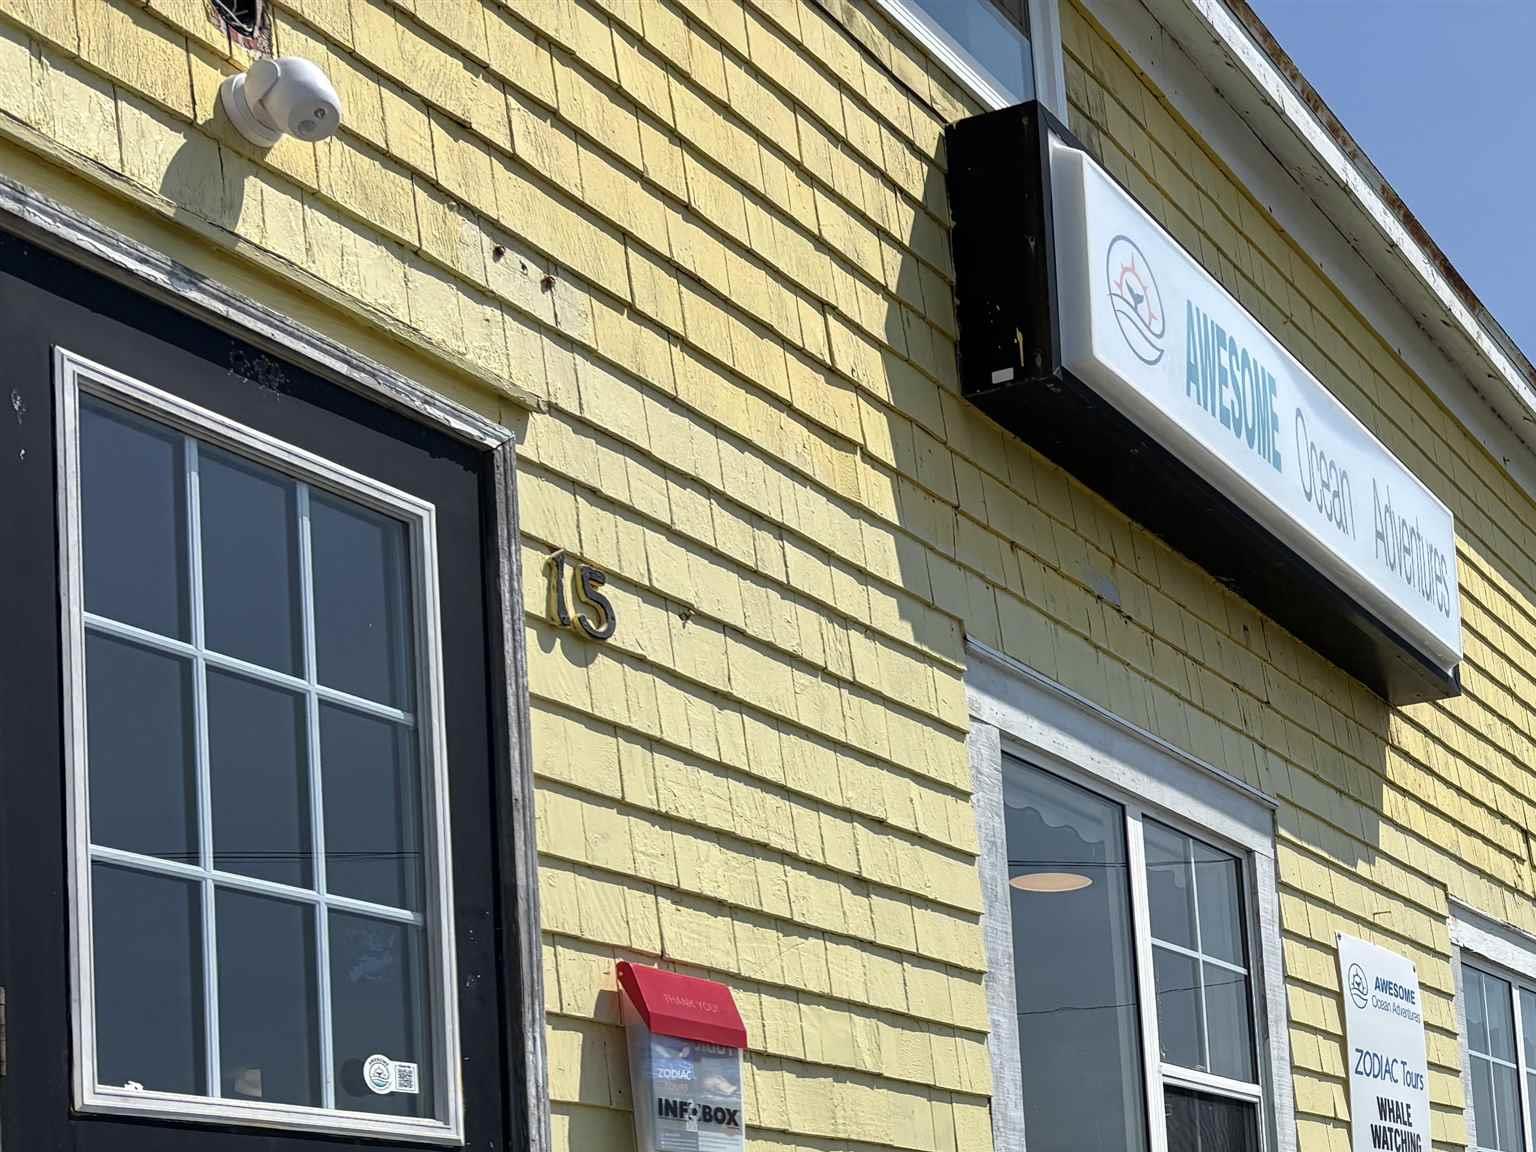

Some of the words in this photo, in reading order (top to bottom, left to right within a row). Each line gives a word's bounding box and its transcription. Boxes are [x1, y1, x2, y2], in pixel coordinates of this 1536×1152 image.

[1187, 300, 1282, 474] AWESOME
[1296, 408, 1356, 540] Ocean
[1372, 477, 1451, 618] Adventures
[546, 549, 616, 640] 15
[1375, 976, 1416, 1005] AWESOME
[1372, 994, 1391, 1012] Ocean
[1391, 1002, 1420, 1024] Adventures
[657, 1067, 692, 1080] ZODIAC
[1354, 1048, 1398, 1083] ZODIAC
[1401, 1060, 1424, 1091] Tours
[1376, 1096, 1413, 1127] WHALE
